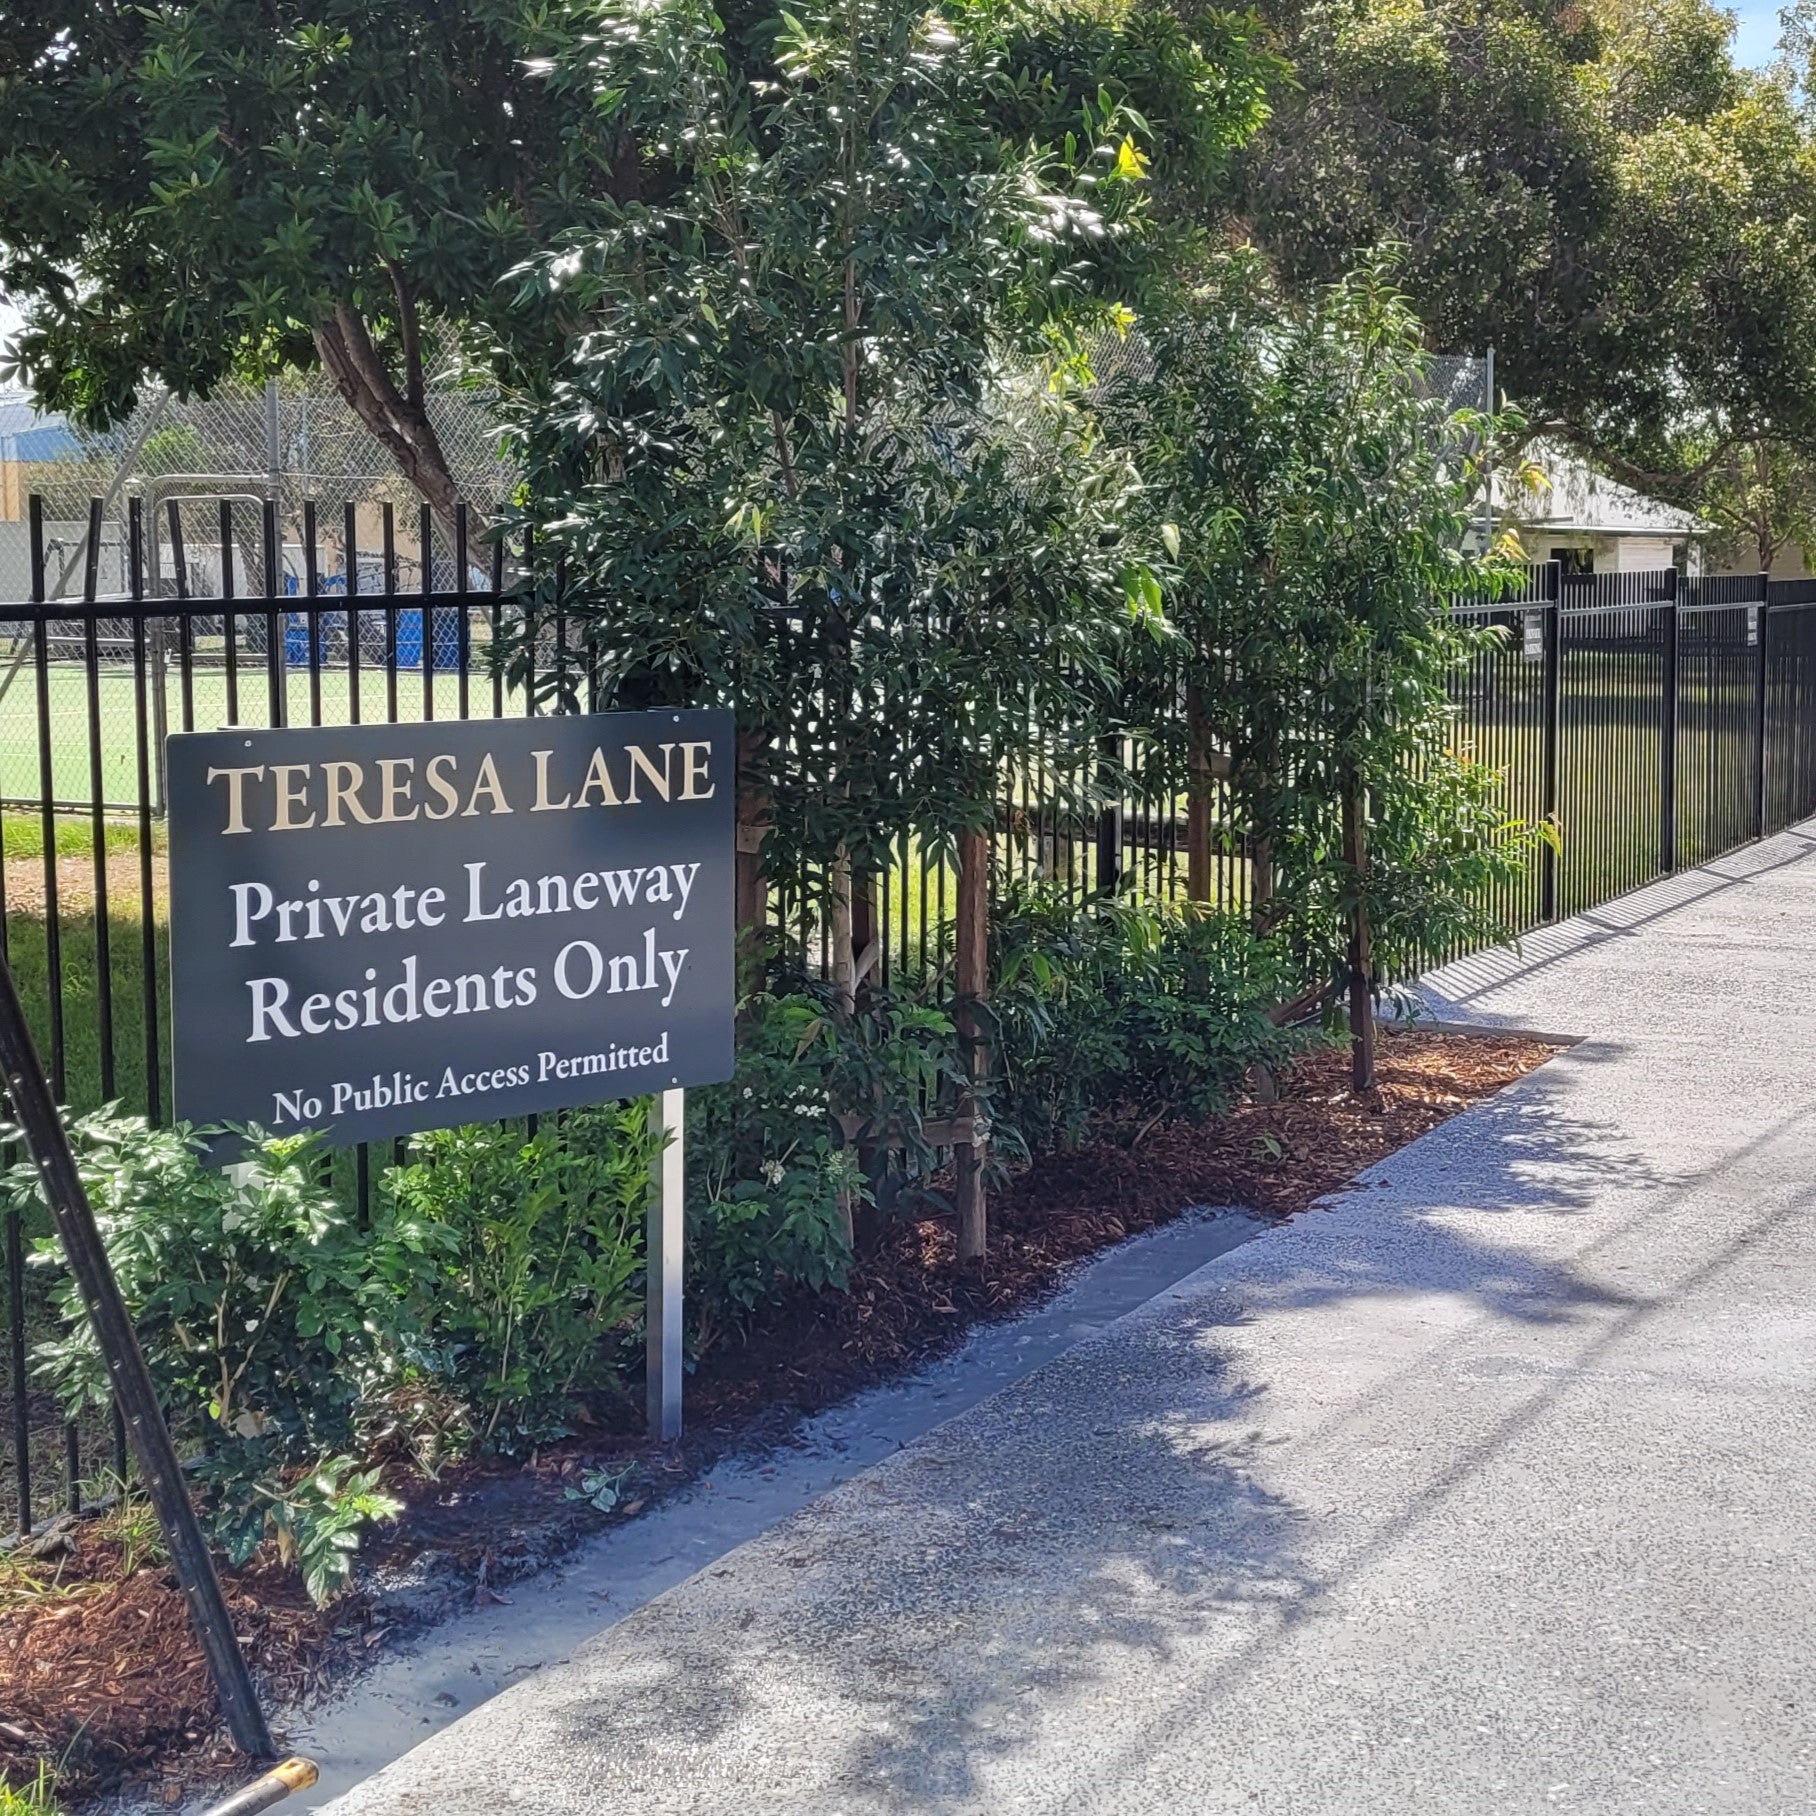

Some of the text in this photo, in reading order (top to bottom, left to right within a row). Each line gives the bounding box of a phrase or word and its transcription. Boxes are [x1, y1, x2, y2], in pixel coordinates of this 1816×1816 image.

[207, 741, 715, 835] TERESA LANE
[229, 861, 700, 947] Private Laneway
[245, 927, 689, 1043] Residents Only
[272, 1032, 669, 1125] No Public Access Permitted
